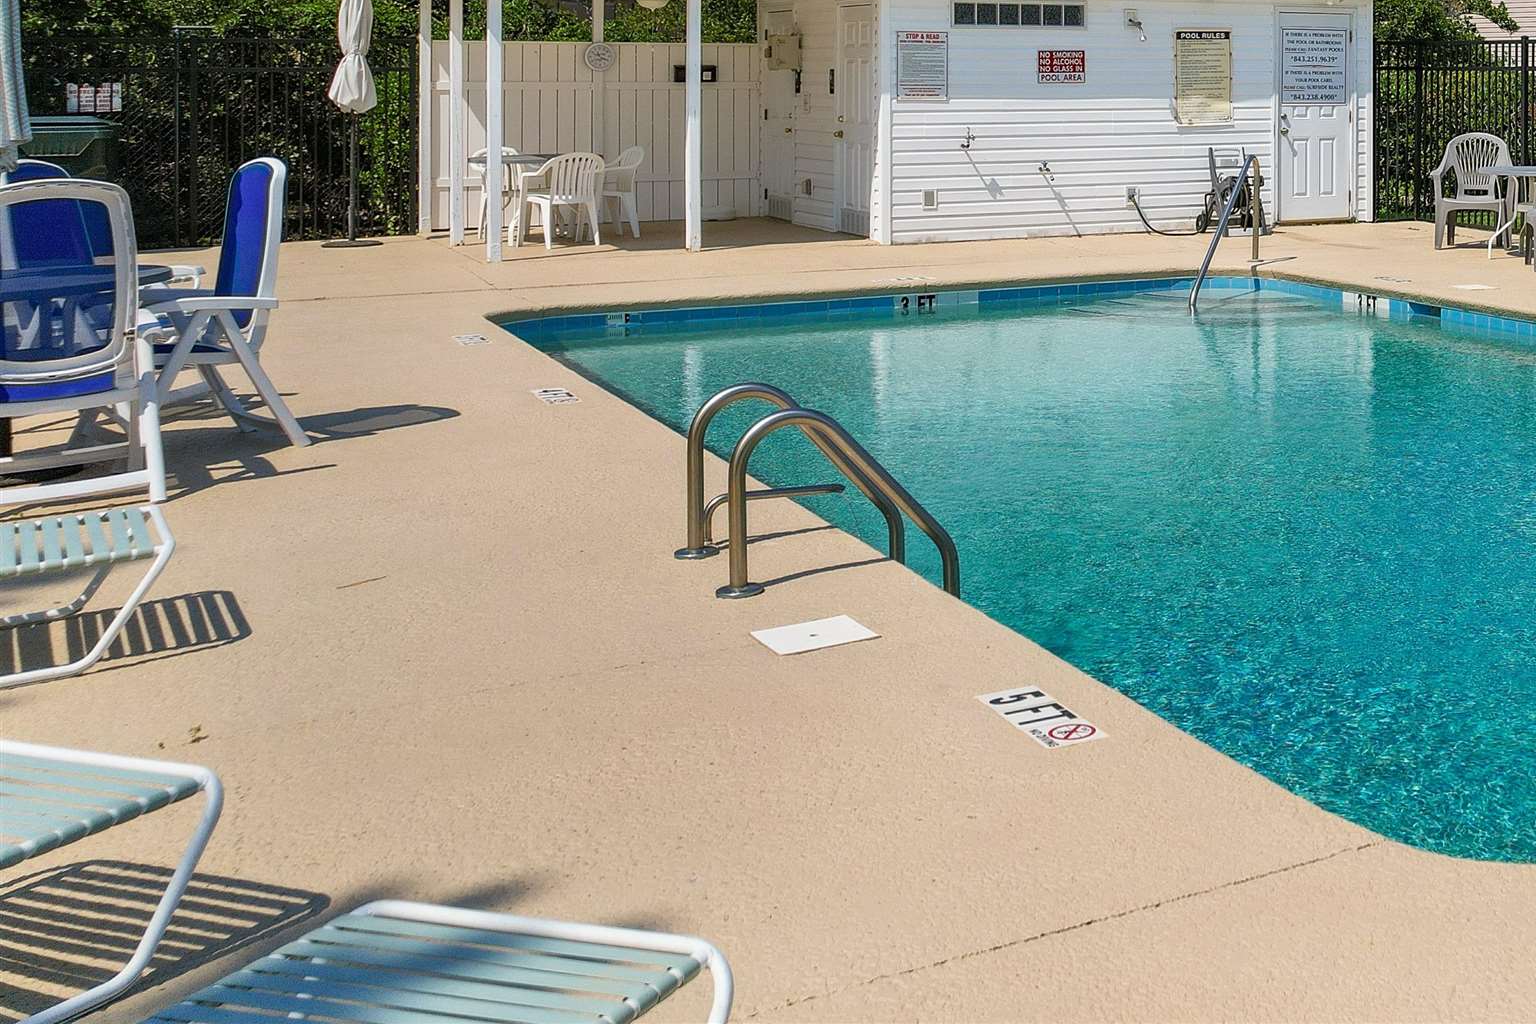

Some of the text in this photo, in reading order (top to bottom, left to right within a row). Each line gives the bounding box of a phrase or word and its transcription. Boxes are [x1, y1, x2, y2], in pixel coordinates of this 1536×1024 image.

[917, 294, 936, 308] FT
[988, 690, 1078, 725] 5 FT
